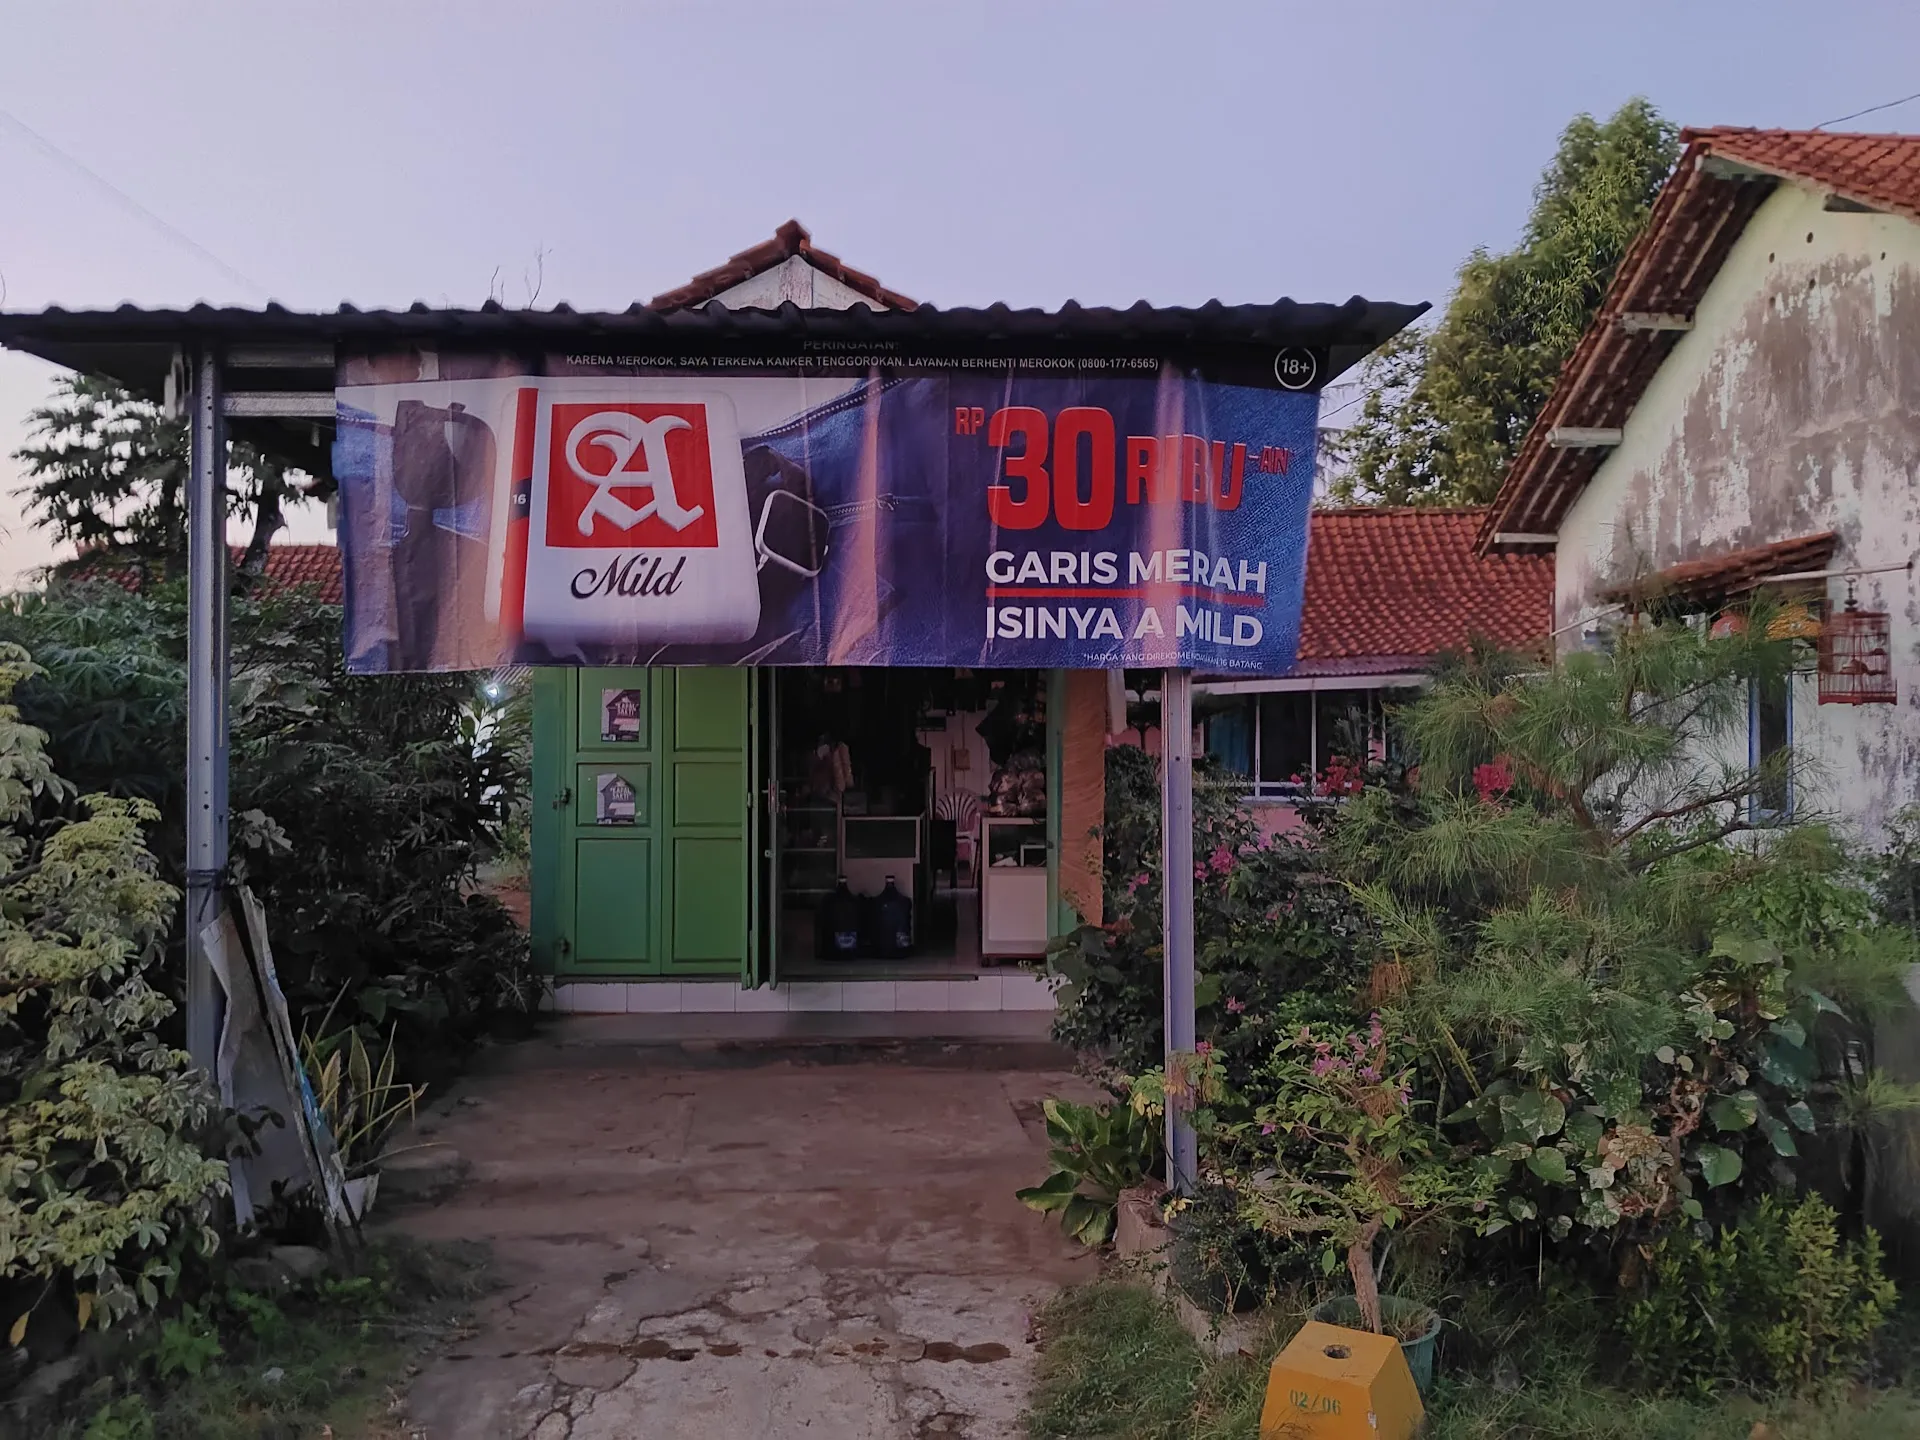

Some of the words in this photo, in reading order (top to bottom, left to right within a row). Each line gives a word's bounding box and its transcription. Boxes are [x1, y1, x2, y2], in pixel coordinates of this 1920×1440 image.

[566, 355, 613, 365] KARENA
[616, 355, 677, 368] MEROKOK,
[680, 356, 708, 366] SAYA
[711, 356, 763, 366] TERKENA
[766, 356, 813, 366] KANKER
[815, 356, 906, 367] TENGGOROKAN.
[908, 357, 959, 367] LAYANAN
[962, 357, 1016, 368] BERHENTI
[1019, 357, 1075, 369] MEROKOK
[1078, 357, 1159, 370] (0800-177-6565)
[1281, 358, 1310, 375] 18+
[565, 410, 705, 537] A
[955, 406, 985, 436] RP
[987, 406, 1116, 530] 30
[512, 493, 527, 505] 16
[570, 552, 687, 599] Mild
[985, 550, 1118, 585] GARIS
[1129, 549, 1267, 594] MERAH
[985, 606, 1123, 640] ISINYA
[1133, 606, 1166, 640] A
[1175, 605, 1264, 647] MILD
[1120, 653, 1145, 662] YANG
[1229, 659, 1263, 670] BATANG
